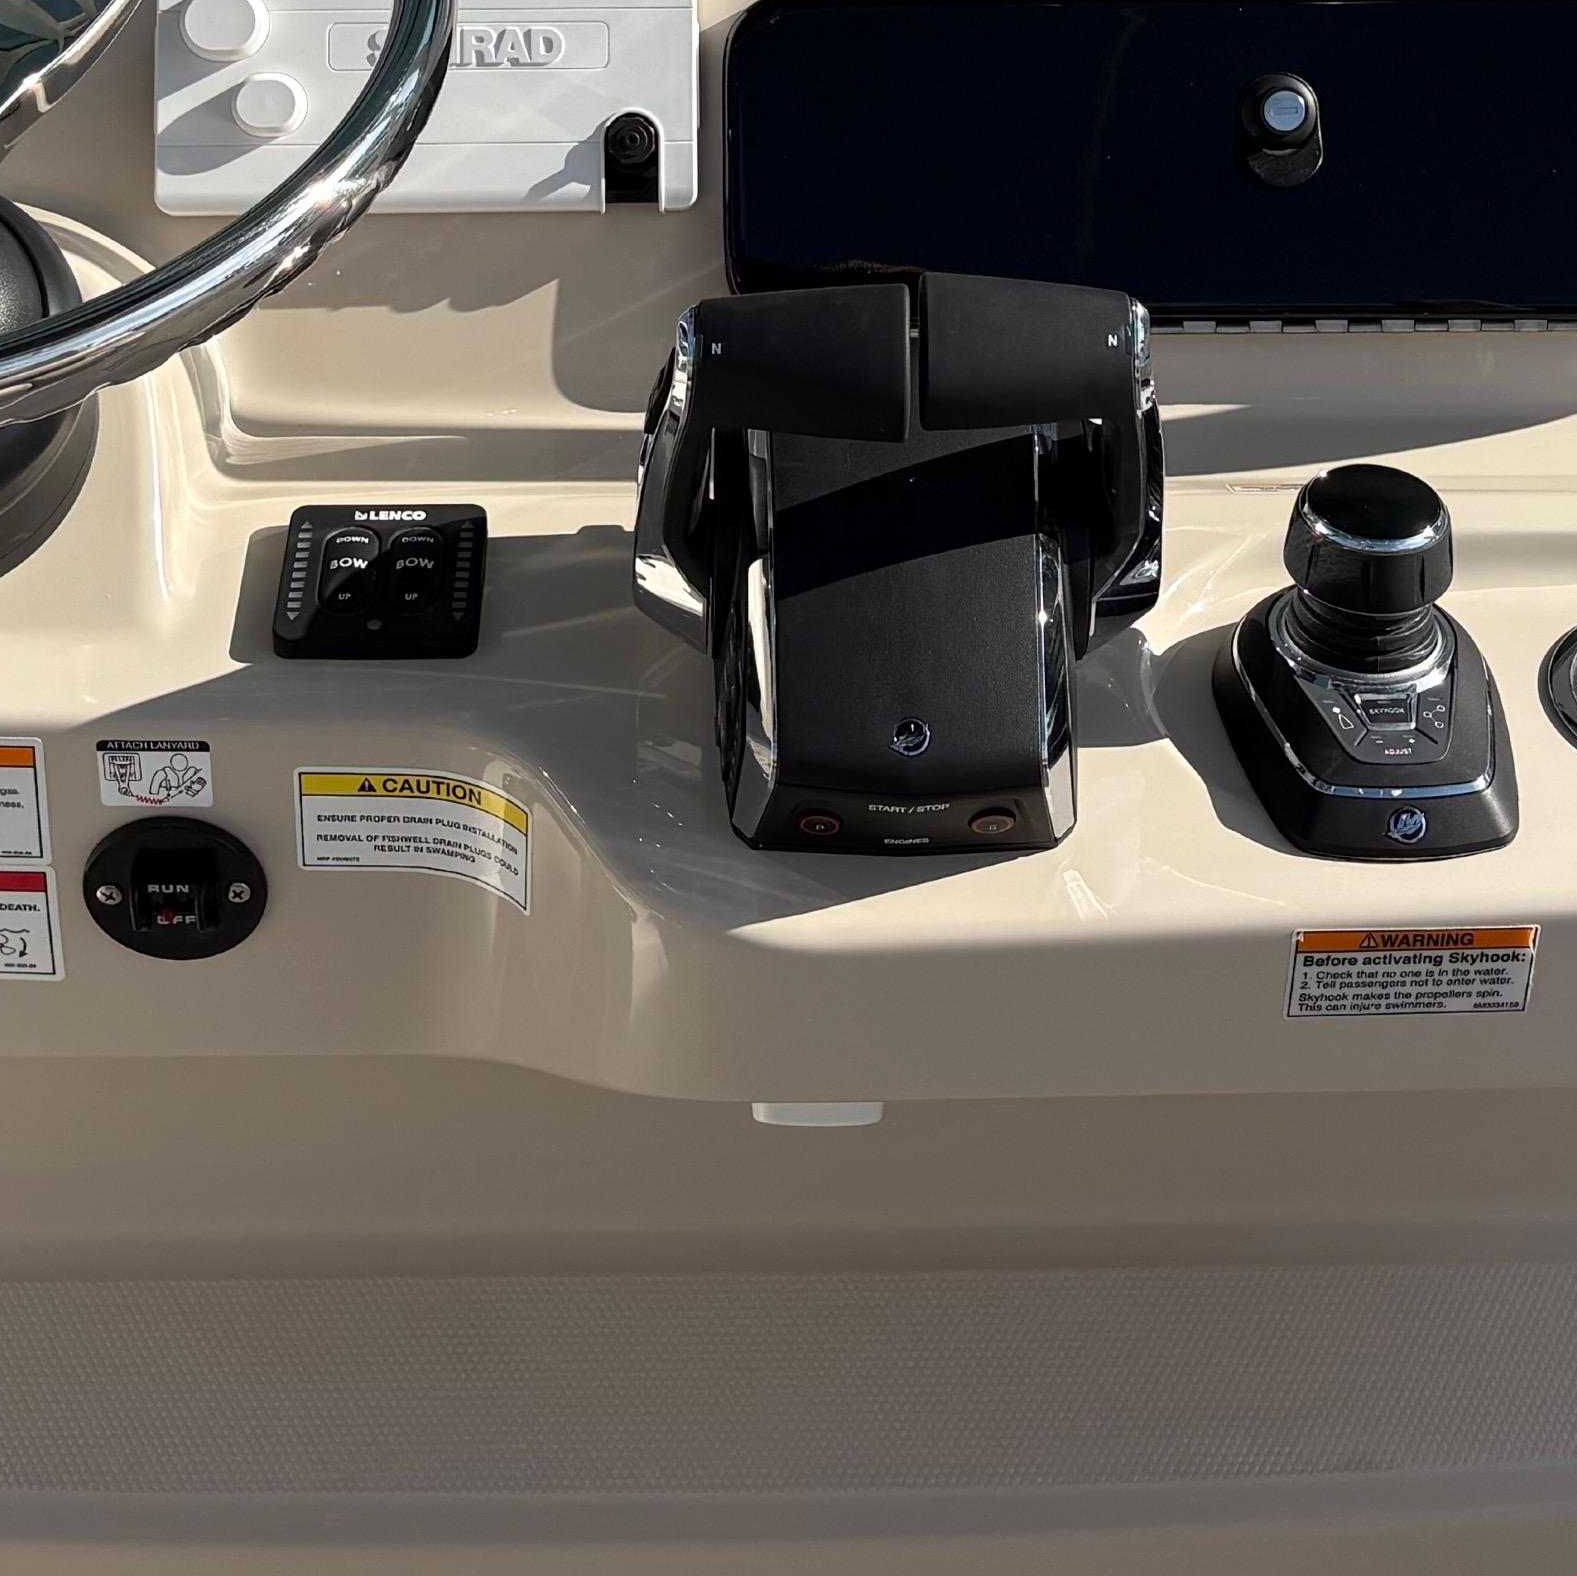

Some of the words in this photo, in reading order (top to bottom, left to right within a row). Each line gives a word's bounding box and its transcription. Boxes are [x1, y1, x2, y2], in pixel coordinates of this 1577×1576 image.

[367, 26, 565, 67] RAD
[1108, 334, 1118, 347] N
[711, 342, 722, 355] N
[369, 510, 427, 521] LENCO
[336, 536, 369, 544] DOWN
[401, 536, 435, 544] DOWN
[329, 557, 368, 570] BOW
[395, 557, 435, 570] BOW
[338, 593, 352, 601] UP
[405, 593, 419, 601] UP
[106, 741, 148, 749] ATTACH
[150, 741, 200, 750] LANYARD
[1384, 747, 1412, 755] ADJUST
[382, 778, 482, 805] CAUTION
[868, 804, 906, 814] START
[916, 803, 951, 813] STOP
[317, 814, 357, 823] ENSURE
[359, 815, 400, 825] PROPER
[402, 816, 433, 825] DRAIN
[436, 818, 461, 829] PLUG
[462, 823, 518, 855] INSTALLATION
[884, 837, 930, 845] ENGINES
[316, 834, 364, 842] REMOVAL
[366, 834, 380, 843] OF
[432, 837, 463, 849] DRAIN
[464, 843, 492, 861] PLUGS
[494, 856, 519, 876] COULD
[373, 844, 411, 853] RESULT
[426, 846, 476, 863] SWAMPING
[147, 884, 190, 893] RUN
[1381, 932, 1474, 948] WARNING
[1302, 954, 1358, 967] Before
[1361, 952, 1444, 967] activating
[1448, 950, 1526, 966] Skyhook:
[1356, 970, 1379, 979] that
[1381, 971, 1396, 979] no
[1424, 968, 1435, 978] is
[1437, 968, 1449, 977] in
[1451, 967, 1470, 977] the
[1473, 967, 1508, 976] water.
[1299, 980, 1311, 990] 2.
[1315, 980, 1337, 989] Tell
[1338, 979, 1407, 990] passengers
[1409, 978, 1429, 987] not
[1431, 977, 1443, 987] to
[1445, 977, 1476, 986] enter
[1478, 976, 1514, 985] water.
[1298, 992, 1348, 1004] Skyhook
[1351, 991, 1391, 1001] makes
[1393, 990, 1412, 1000] the
[1414, 989, 1472, 1001] propellers
[1475, 988, 1503, 999] spin.
[1297, 1002, 1322, 1012] This
[1324, 1003, 1347, 1011] can
[1349, 1001, 1382, 1012] injure
[1384, 999, 1446, 1010] swimmers.
